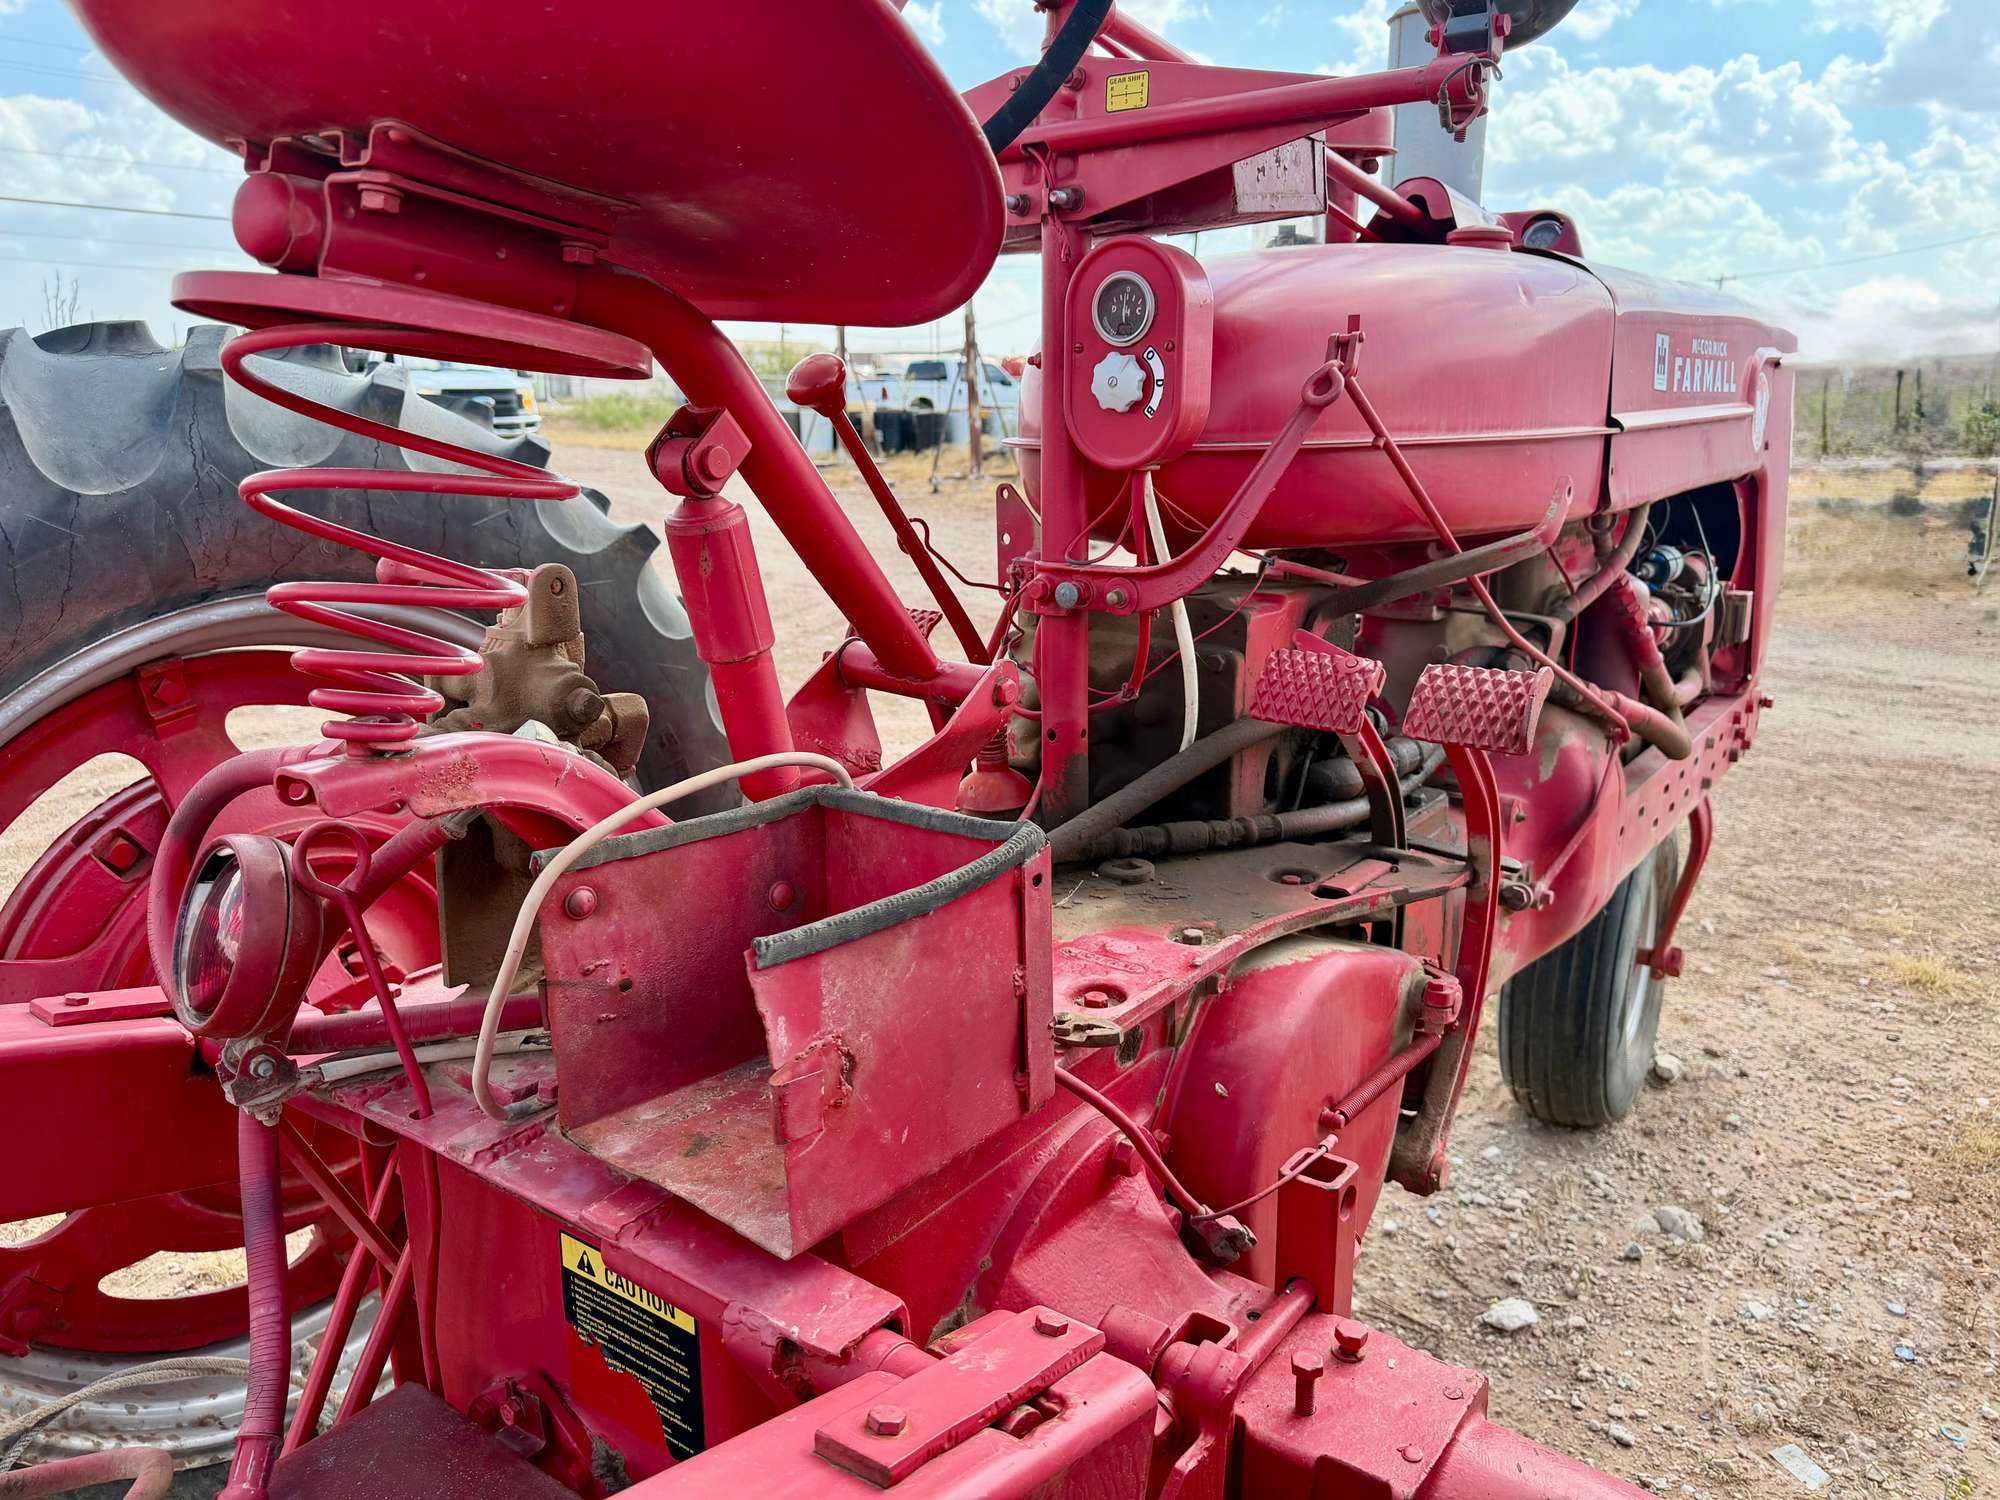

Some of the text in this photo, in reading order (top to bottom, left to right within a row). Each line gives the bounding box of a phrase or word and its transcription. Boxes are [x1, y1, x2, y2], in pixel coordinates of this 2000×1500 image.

[1110, 74, 1145, 85] GEAR SHIFT
[1112, 305, 1117, 313] D
[1136, 307, 1141, 315] C
[1673, 356, 1737, 393] FARMALL
[1156, 378, 1164, 387] D
[1146, 406, 1155, 416] B
[604, 1267, 676, 1320] CAUTION
